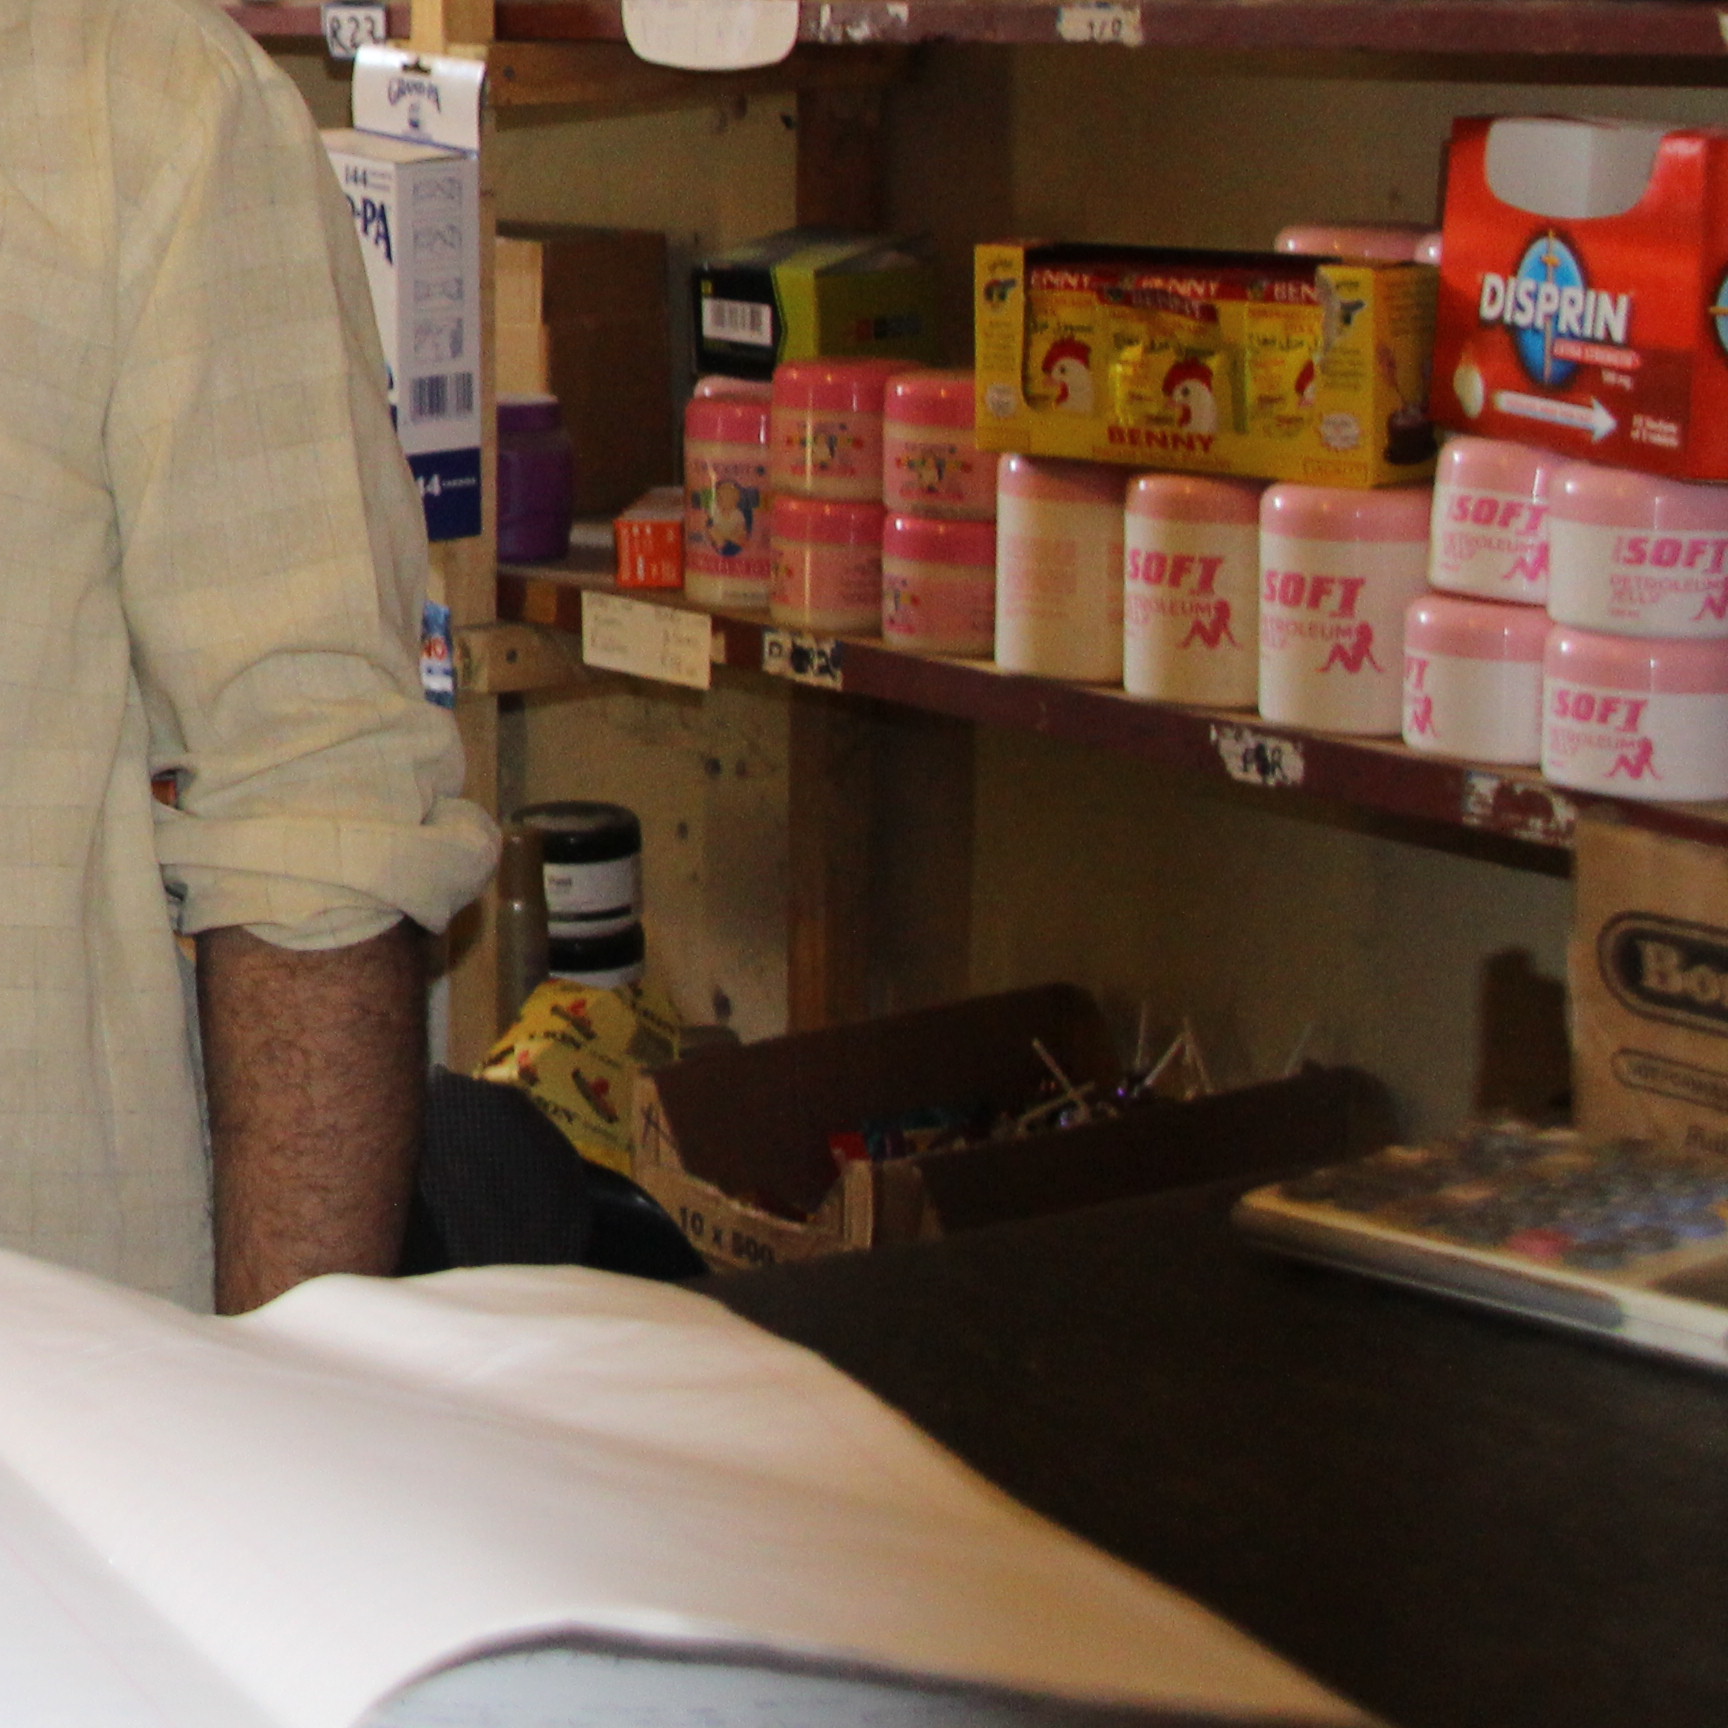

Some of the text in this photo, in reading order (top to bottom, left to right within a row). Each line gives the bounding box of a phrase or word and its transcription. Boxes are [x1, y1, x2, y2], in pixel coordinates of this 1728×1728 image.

[1030, 268, 1092, 290] ENNY
[1274, 280, 1319, 303] BEN
[1478, 271, 1630, 345] DISPRIN
[1106, 424, 1215, 454] BENNY
[1452, 495, 1549, 536] SOFT
[1127, 548, 1225, 595] SOFT
[1623, 536, 1728, 574] SOFT
[1263, 569, 1366, 619] SOFT
[1554, 688, 1649, 733] SOFT
[1638, 937, 1726, 1003] Bo
[677, 1204, 705, 1236] 10
